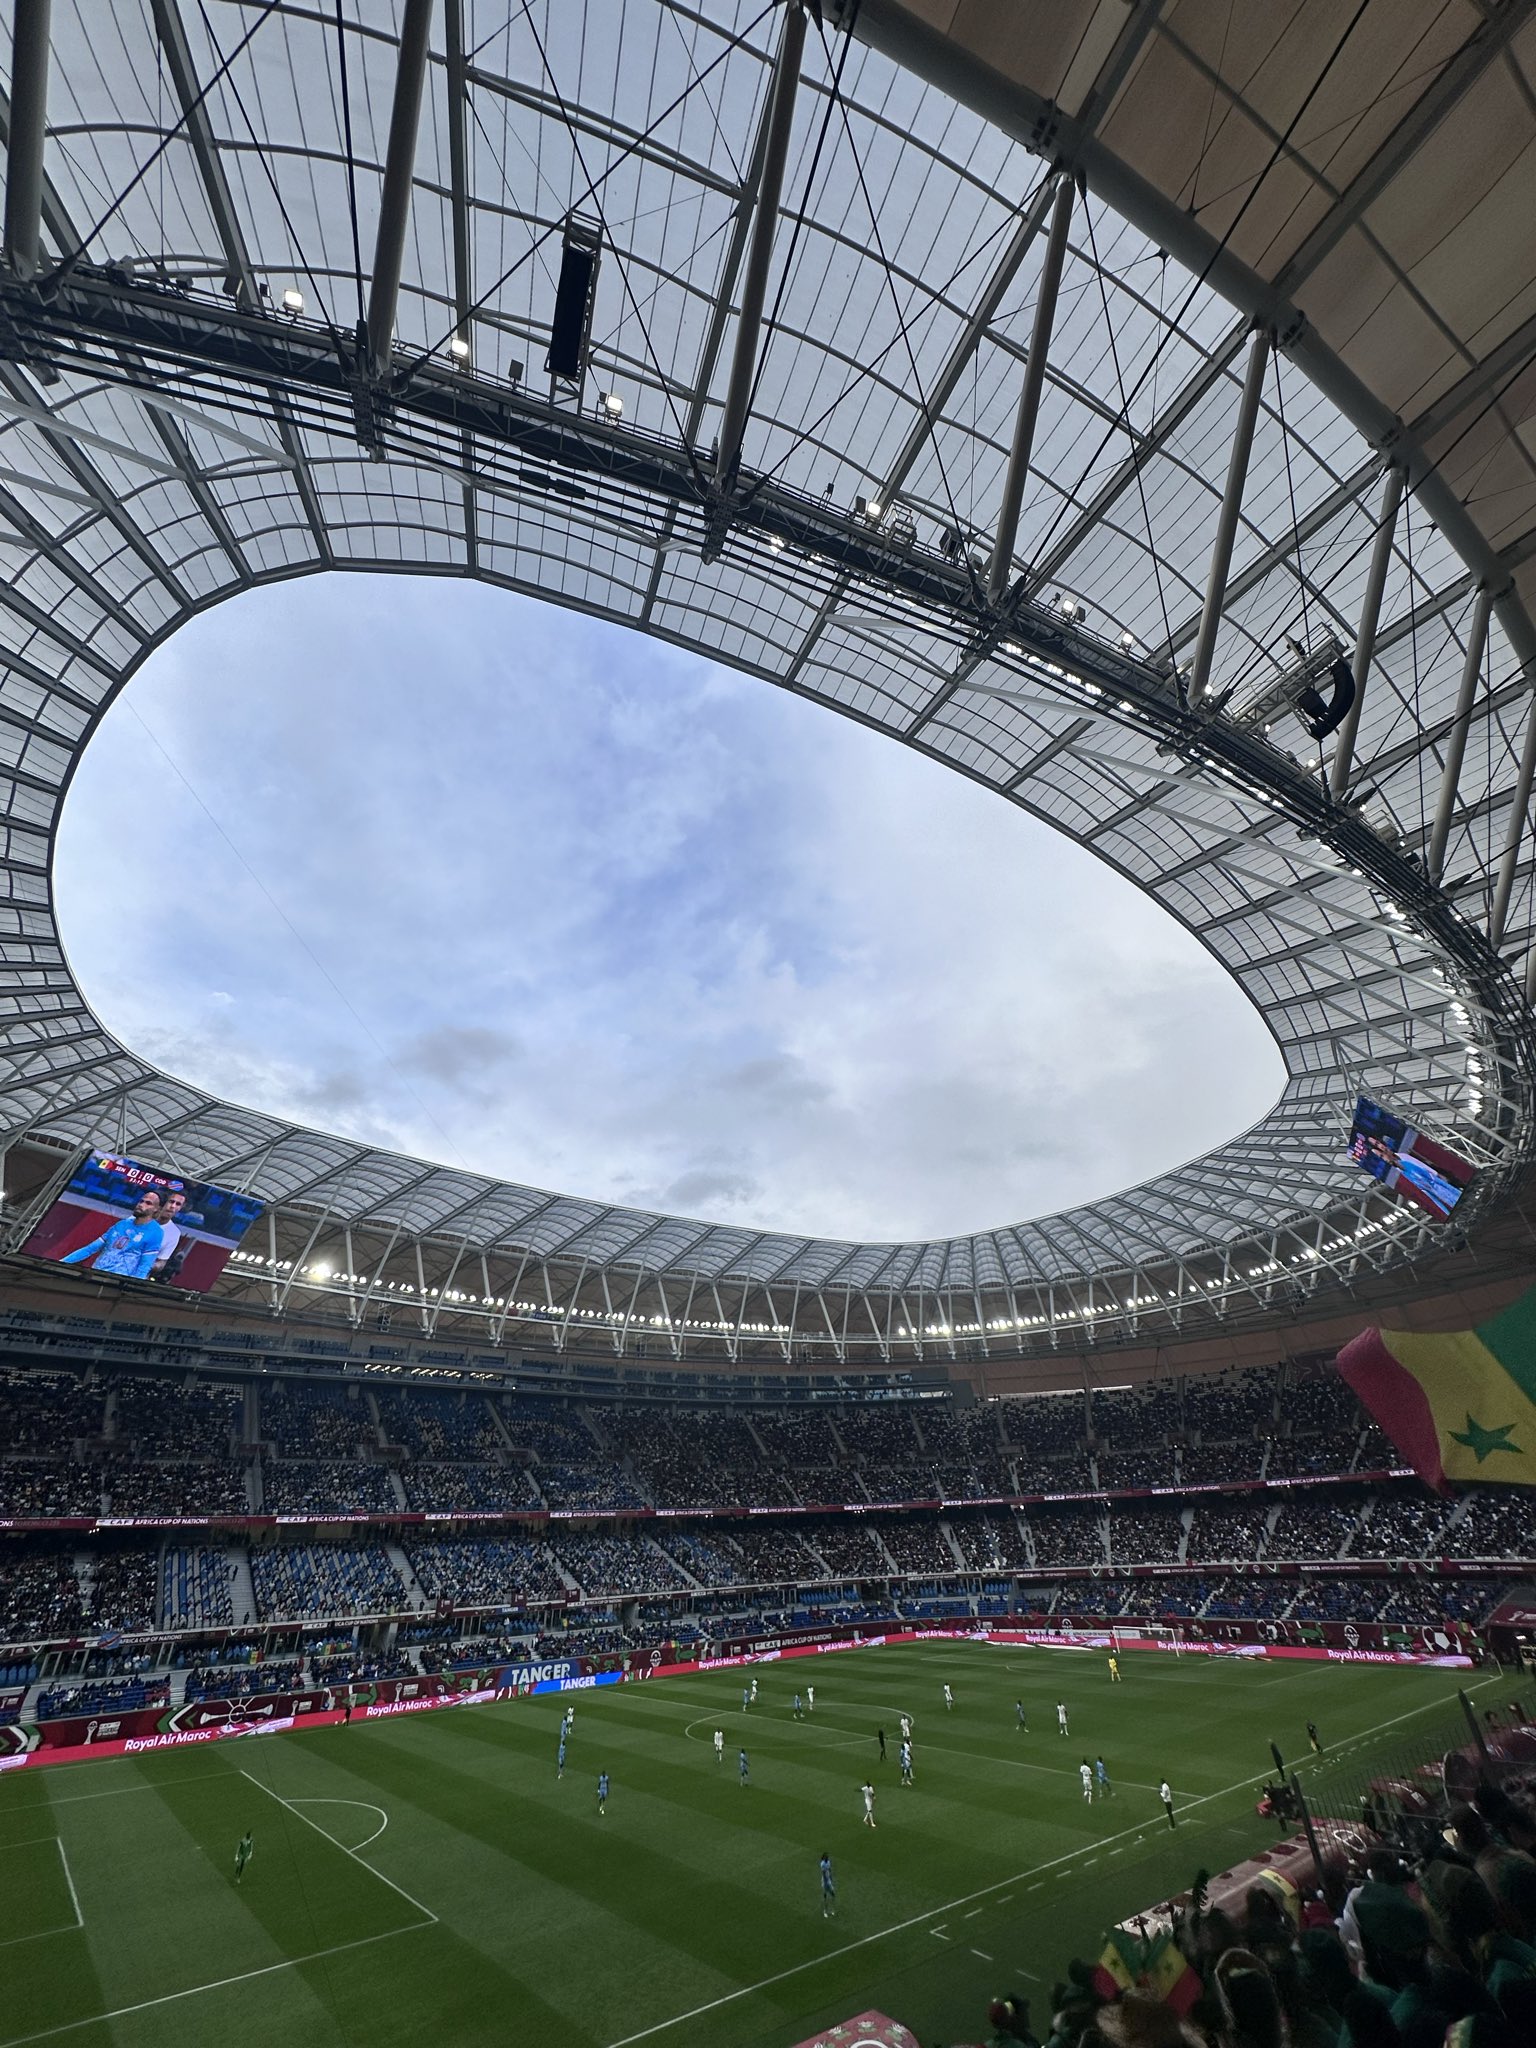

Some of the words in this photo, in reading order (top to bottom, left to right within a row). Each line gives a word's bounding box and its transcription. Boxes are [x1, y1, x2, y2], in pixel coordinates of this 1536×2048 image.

[781, 1638, 798, 1646] AFRICA
[813, 1633, 832, 1641] NATIONS
[1177, 1642, 1187, 1650] Air
[1187, 1642, 1209, 1652] Maroc
[1328, 1650, 1352, 1662] Royal
[1352, 1651, 1366, 1659] Air
[1367, 1652, 1395, 1661] Maroc
[699, 1659, 715, 1670] Royal
[715, 1658, 724, 1666] Air
[724, 1657, 741, 1665] Maroc
[511, 1663, 571, 1685] TANGER
[560, 1676, 596, 1690] TANGER
[367, 1703, 392, 1717] Royal
[392, 1702, 405, 1712] Air
[405, 1699, 432, 1710] Maroc
[125, 1737, 158, 1751] Royal
[158, 1734, 176, 1746] Air
[176, 1729, 212, 1743] Maroc
